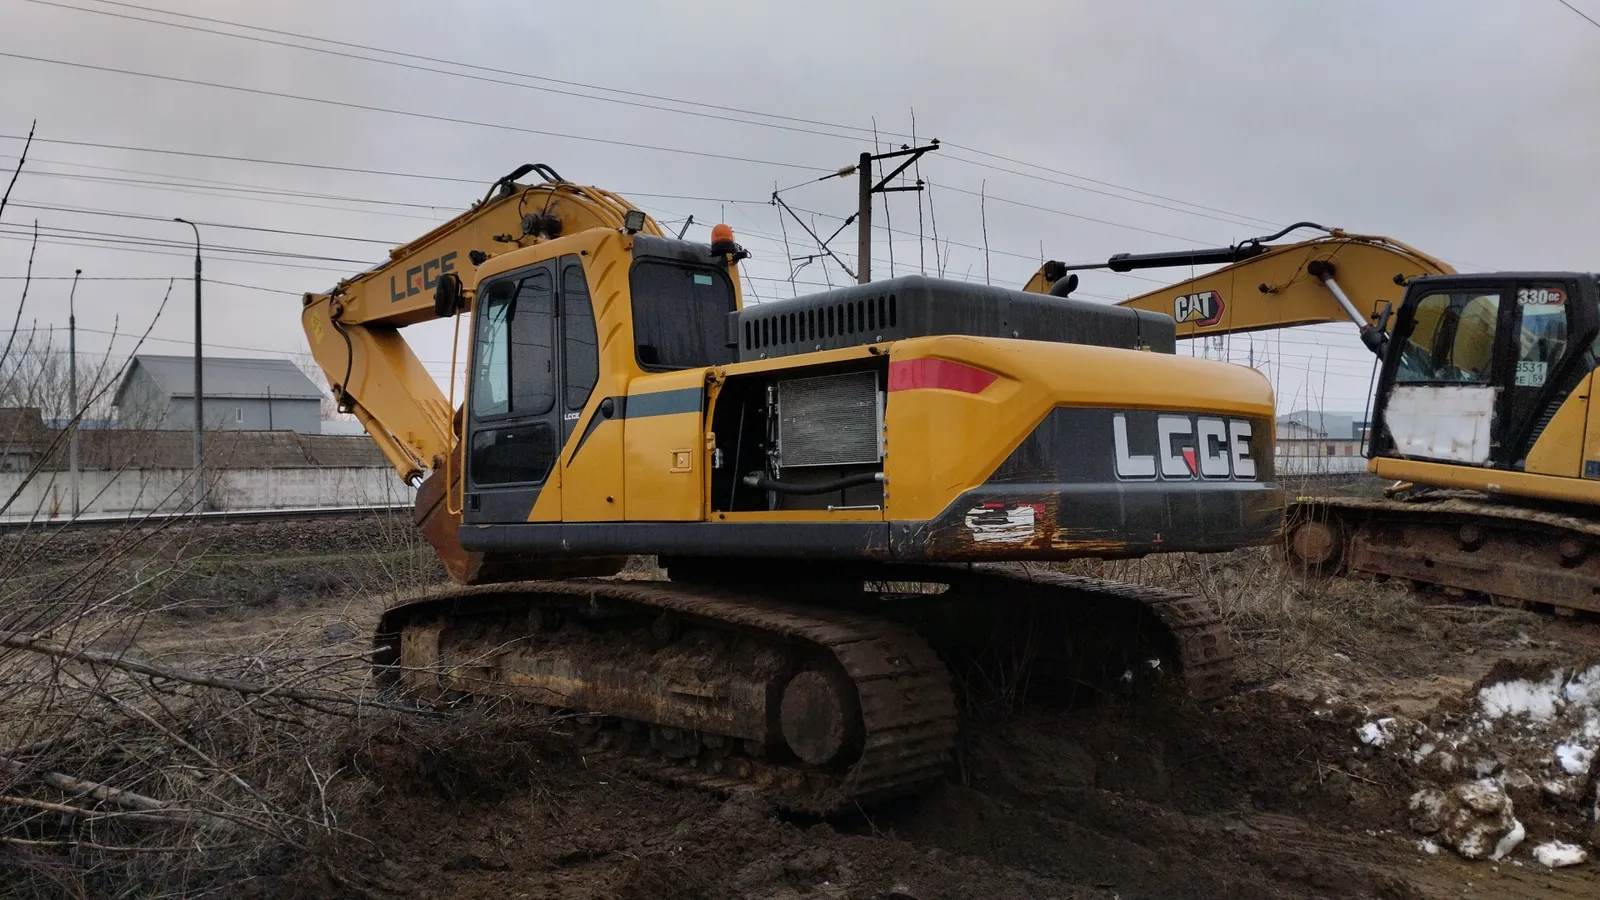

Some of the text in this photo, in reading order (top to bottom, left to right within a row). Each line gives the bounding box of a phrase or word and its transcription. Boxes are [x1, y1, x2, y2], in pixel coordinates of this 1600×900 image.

[1174, 291, 1212, 323] CAT
[1532, 374, 1543, 383] 59
[1113, 413, 1257, 481] LGCE
